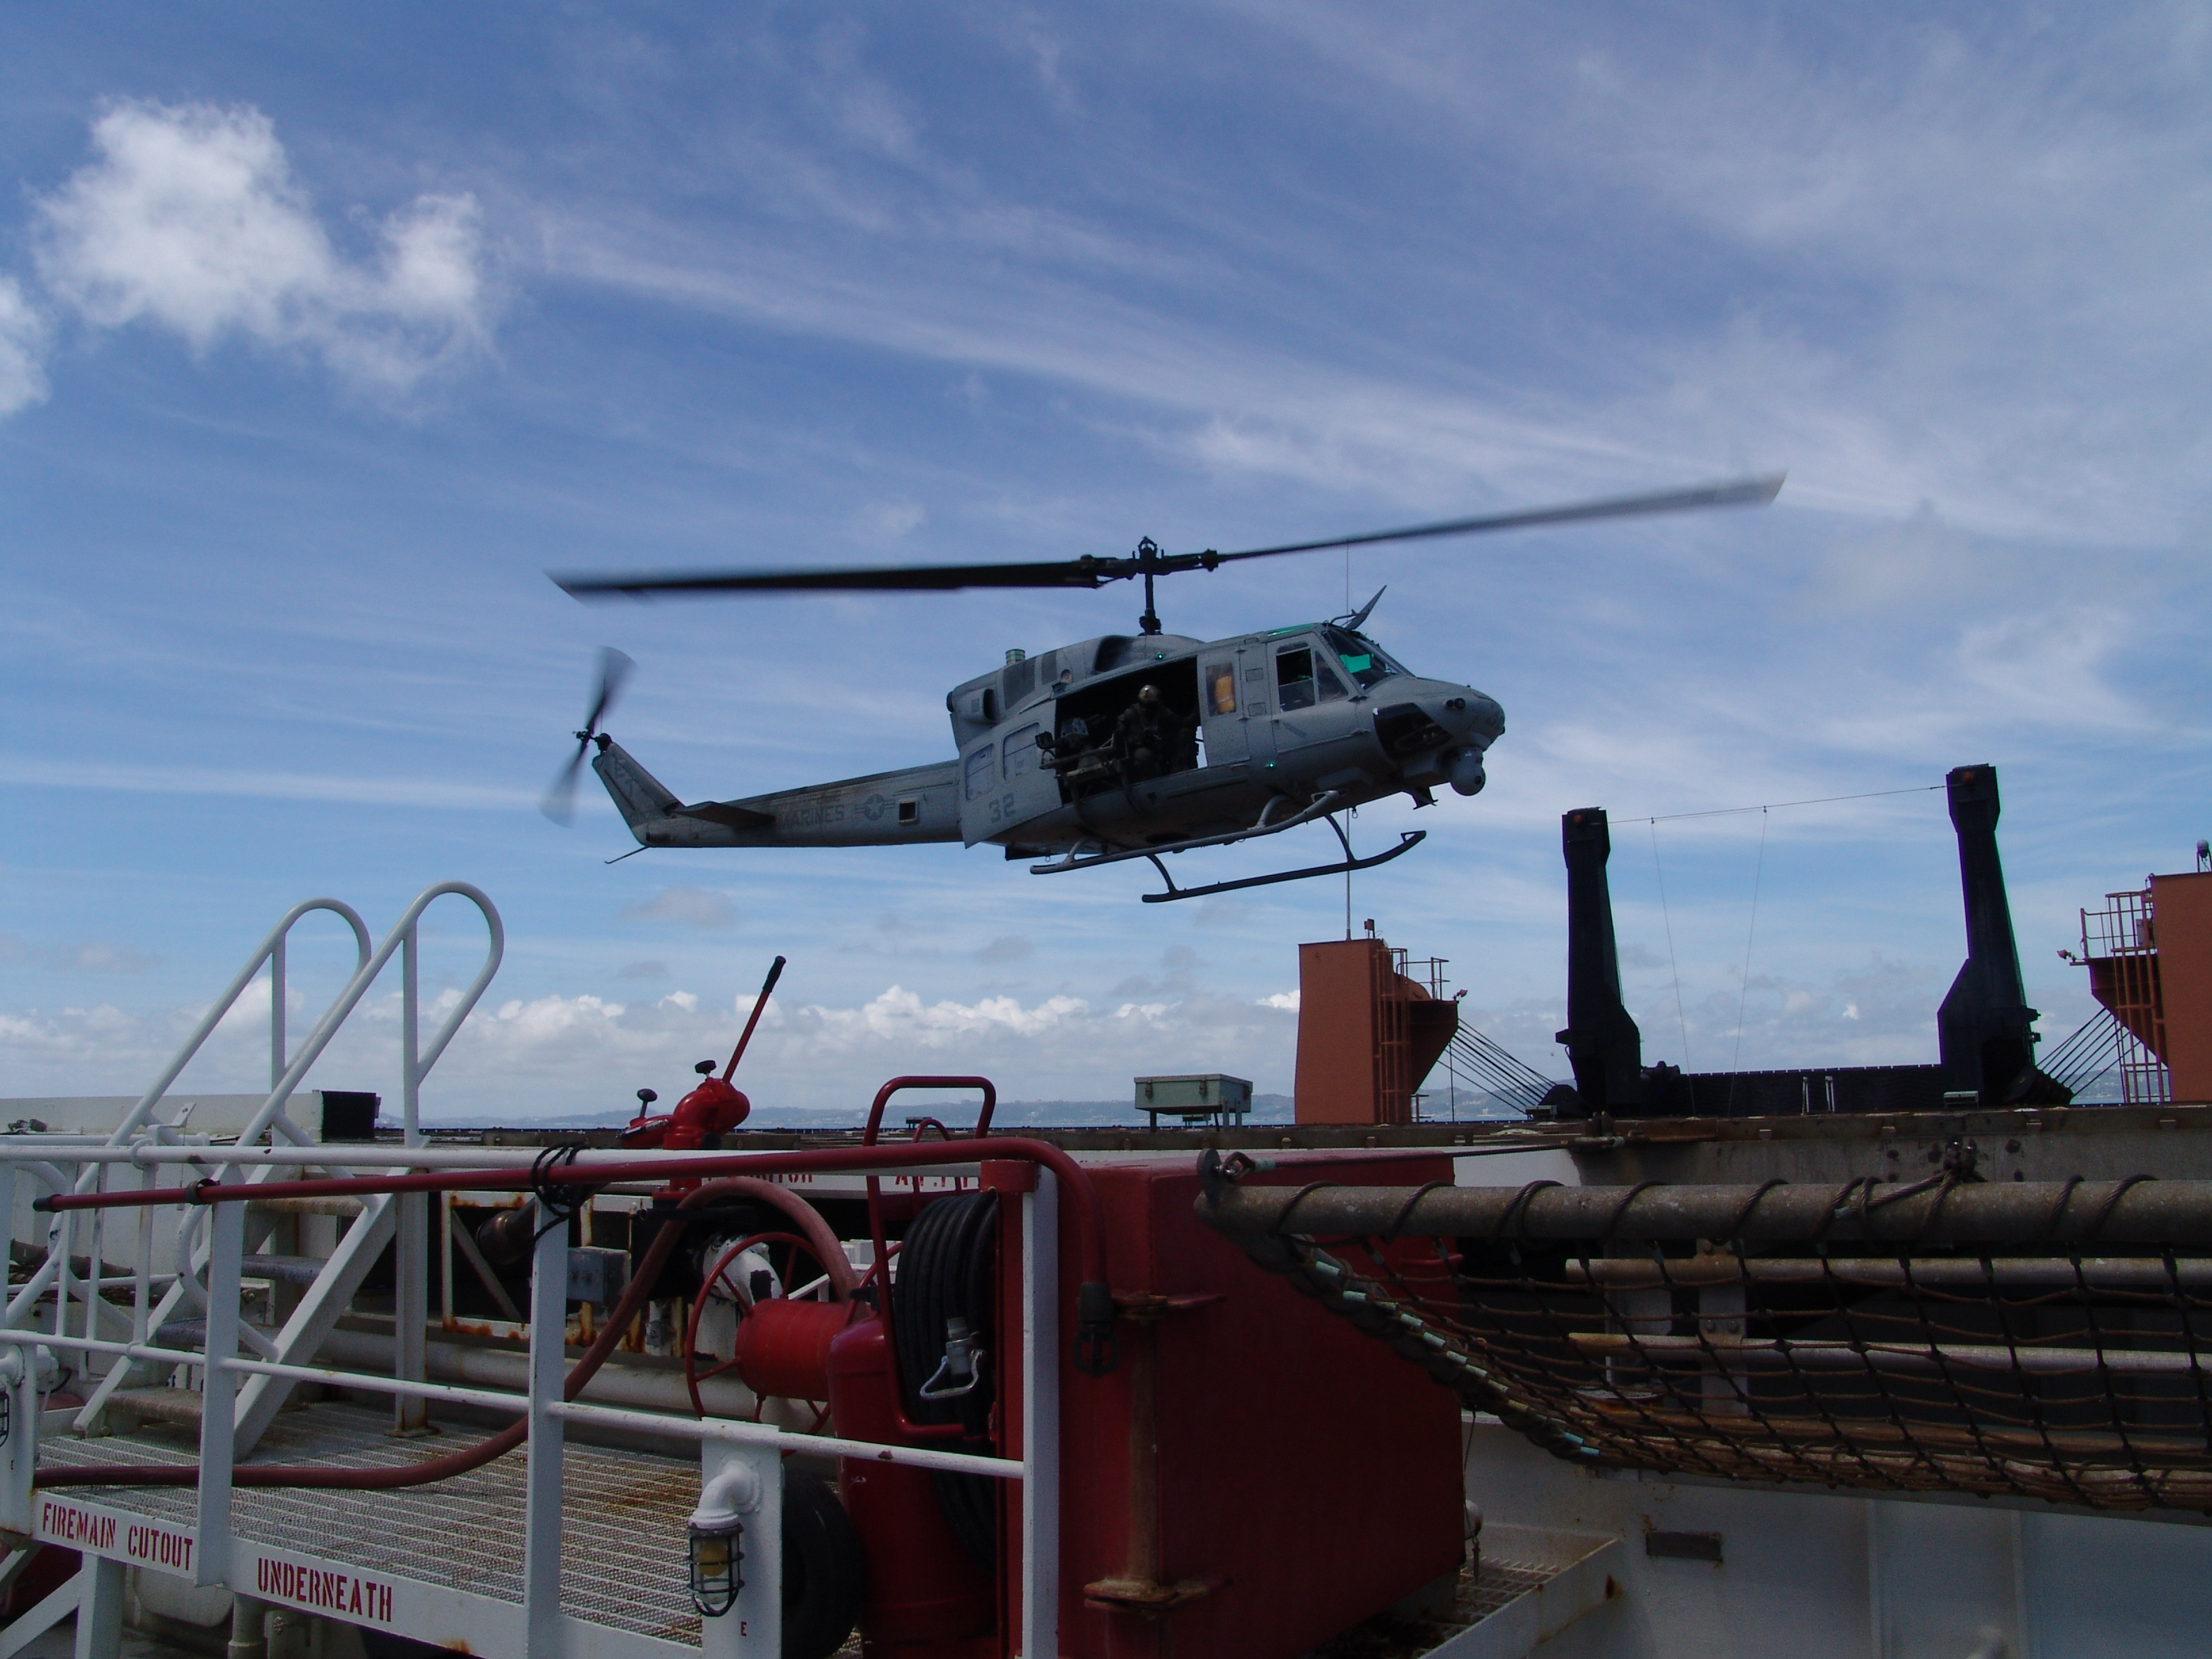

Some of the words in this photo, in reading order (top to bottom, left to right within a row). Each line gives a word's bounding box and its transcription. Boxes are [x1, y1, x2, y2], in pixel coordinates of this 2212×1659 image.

[777, 804, 844, 828] MARINES
[989, 793, 1016, 823] 32
[43, 1502, 116, 1548] FIREMAIN
[128, 1525, 193, 1571] CUTOUT
[258, 1558, 392, 1622] UNDERNEATH
[741, 1621, 747, 1637] E
